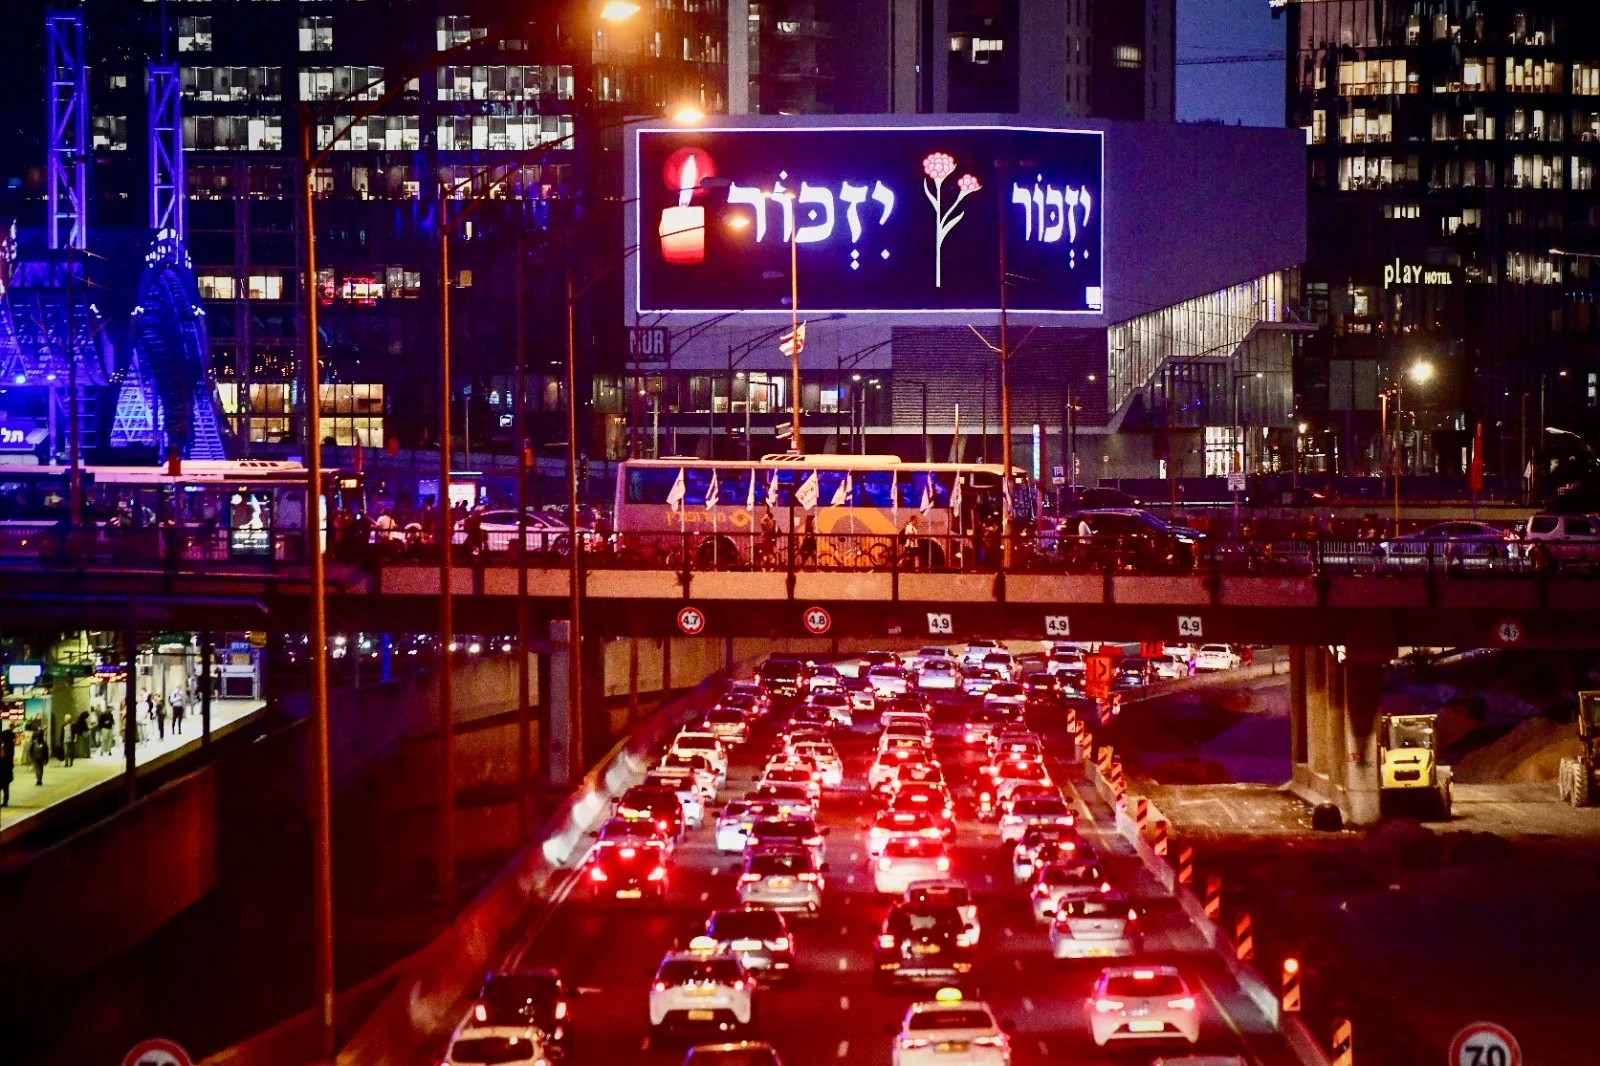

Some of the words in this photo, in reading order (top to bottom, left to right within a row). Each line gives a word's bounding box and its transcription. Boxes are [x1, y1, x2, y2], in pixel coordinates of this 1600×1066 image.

[1424, 271, 1453, 285] HOTEL
[0, 426, 24, 443] תל
[683, 615, 698, 625] 4.7
[809, 615, 826, 625] 4.8
[931, 618, 949, 629] 4.9
[1049, 620, 1067, 631] 4.9
[1181, 620, 1200, 632] 4.9
[1464, 1044, 1506, 1066] 70
